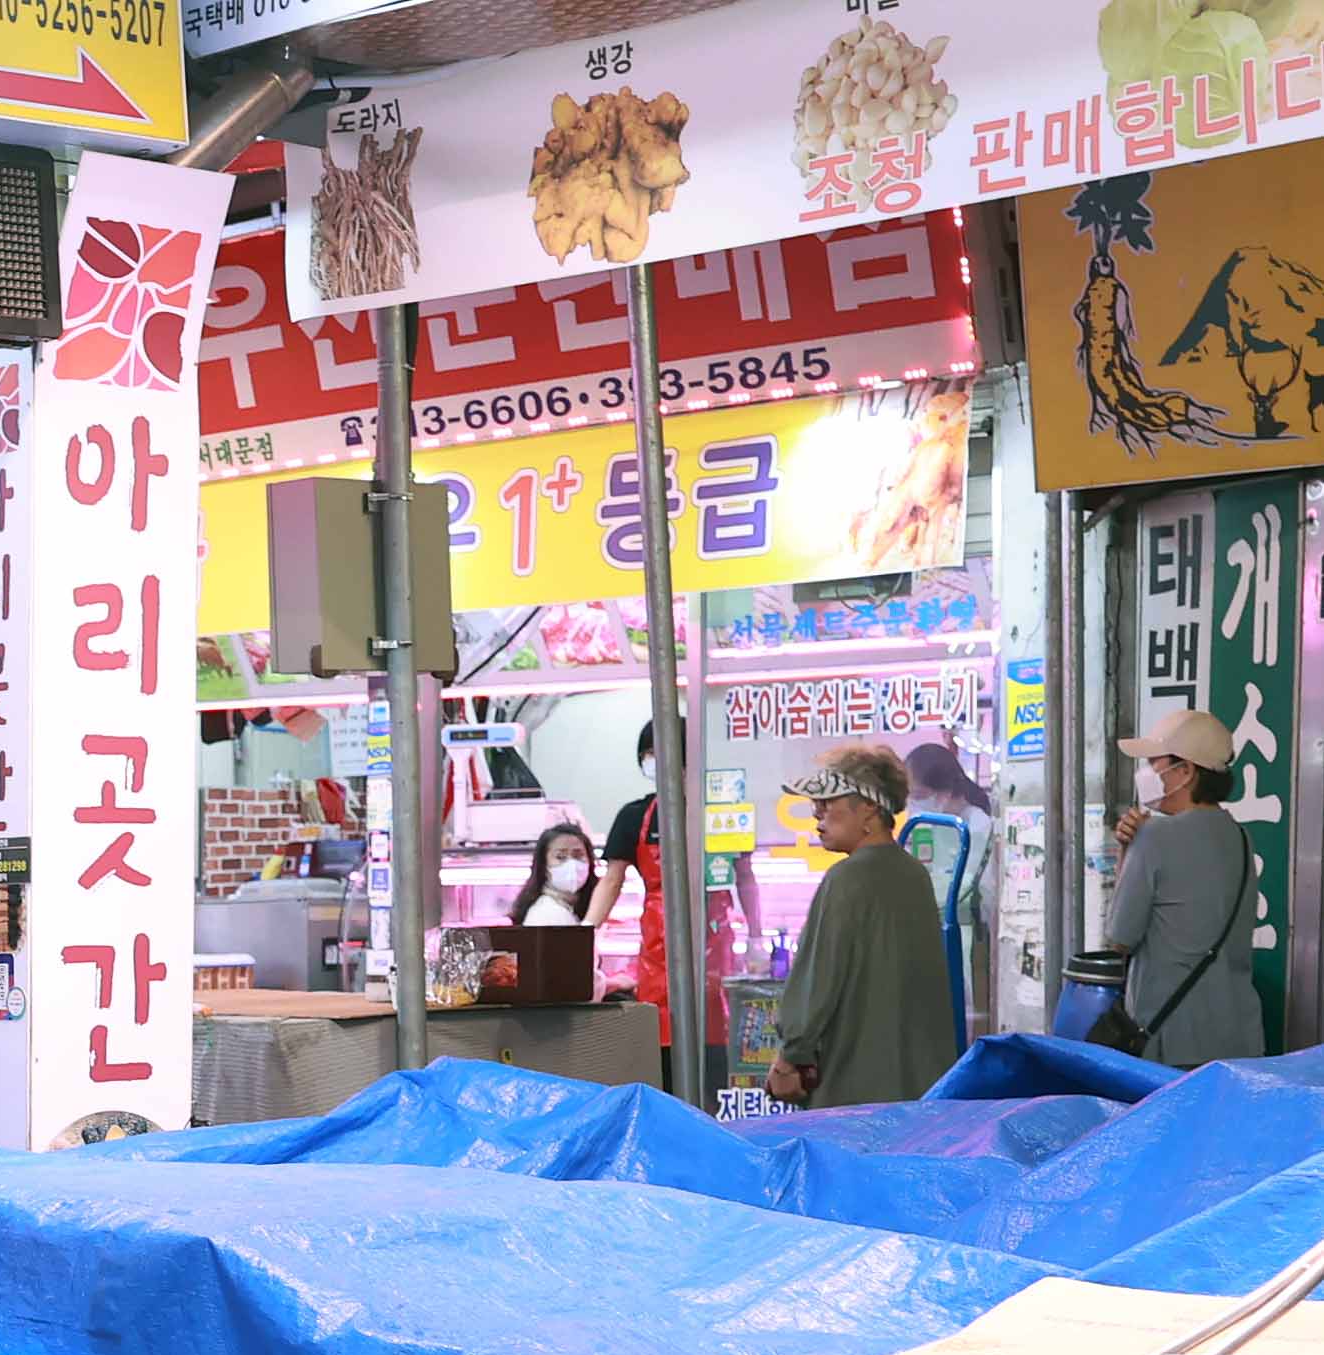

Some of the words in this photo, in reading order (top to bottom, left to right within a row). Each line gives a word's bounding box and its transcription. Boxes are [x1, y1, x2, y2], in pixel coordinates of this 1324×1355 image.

[584, 40, 635, 81] 생강
[330, 98, 402, 135] 도라지
[798, 130, 927, 224] 조청
[729, 680, 873, 739] 살아숨쉬는
[887, 668, 979, 732] 생고기
[62, 415, 170, 1083] 아리곳간
